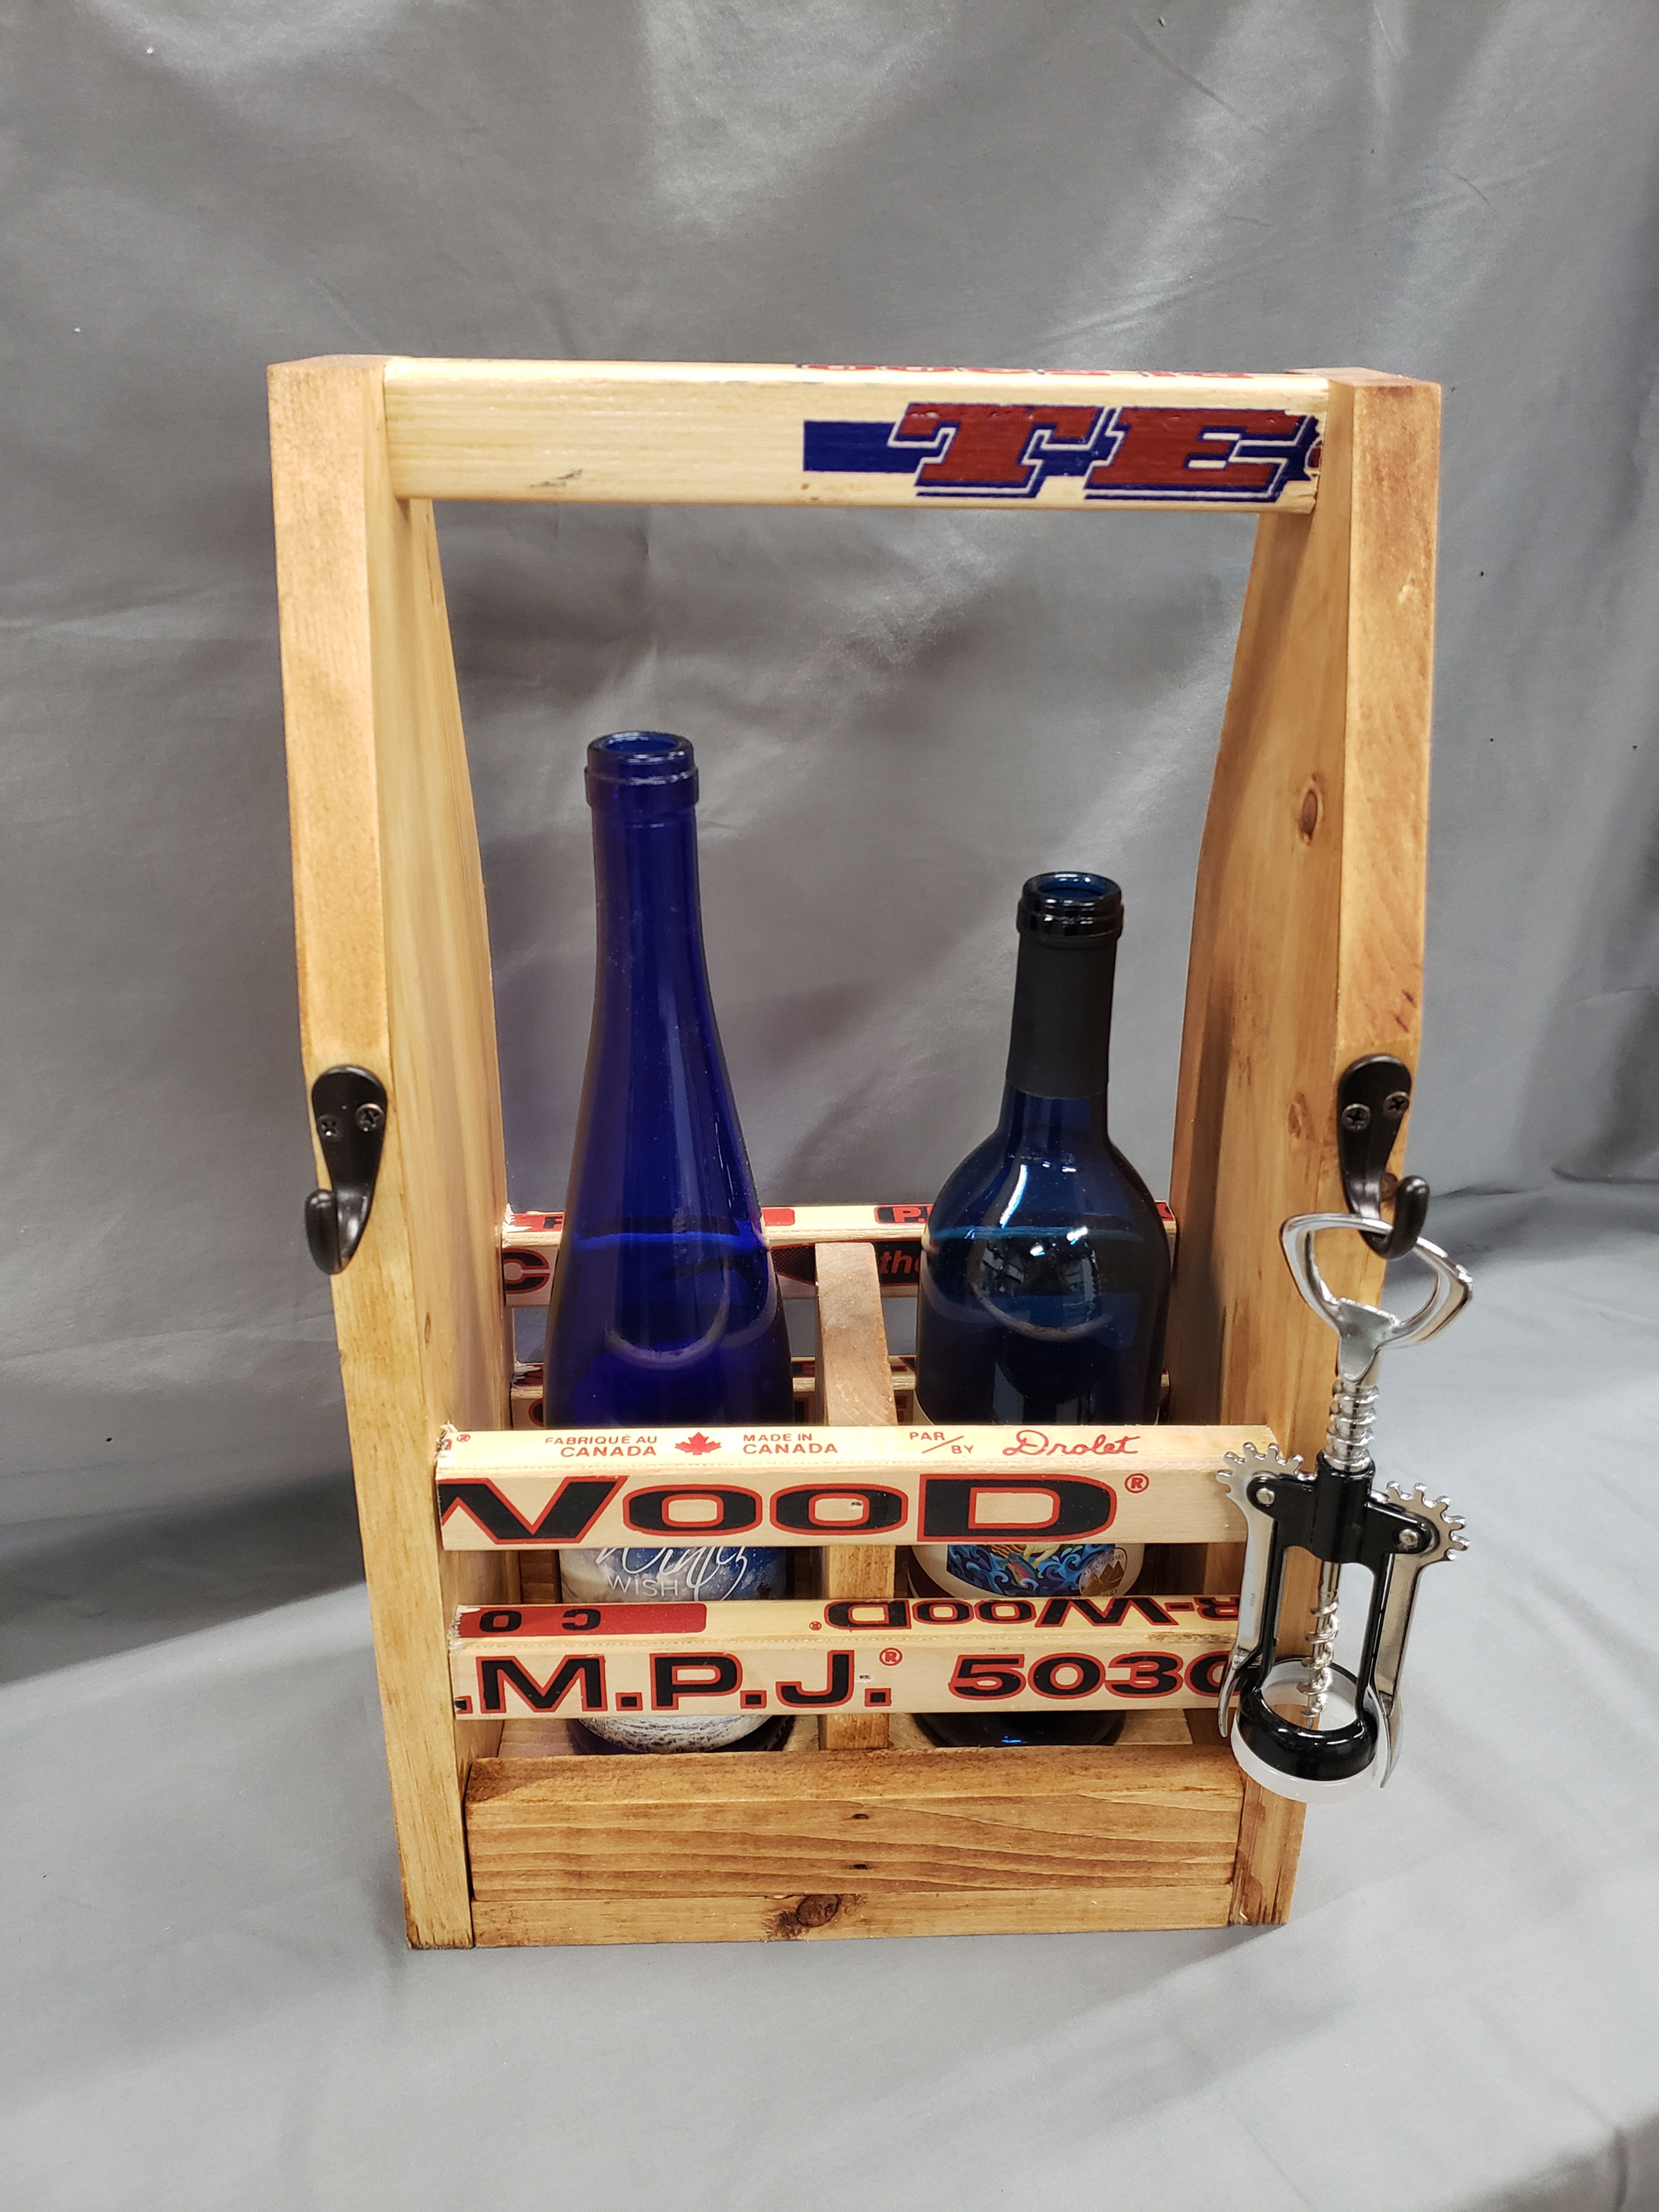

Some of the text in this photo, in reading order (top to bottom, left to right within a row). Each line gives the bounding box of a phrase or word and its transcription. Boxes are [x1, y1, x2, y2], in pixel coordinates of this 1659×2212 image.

[888, 402, 1320, 503] TE
[880, 1250, 919, 1274] th
[545, 1434, 657, 1444] FABRIQUÉ AU
[909, 1432, 945, 1441] PAR
[1002, 1430, 1141, 1455] Drolet
[560, 1446, 657, 1457] CANADA
[743, 1443, 838, 1454] CANADA
[951, 1444, 974, 1454] BY
[607, 1575, 679, 1597] WISH
